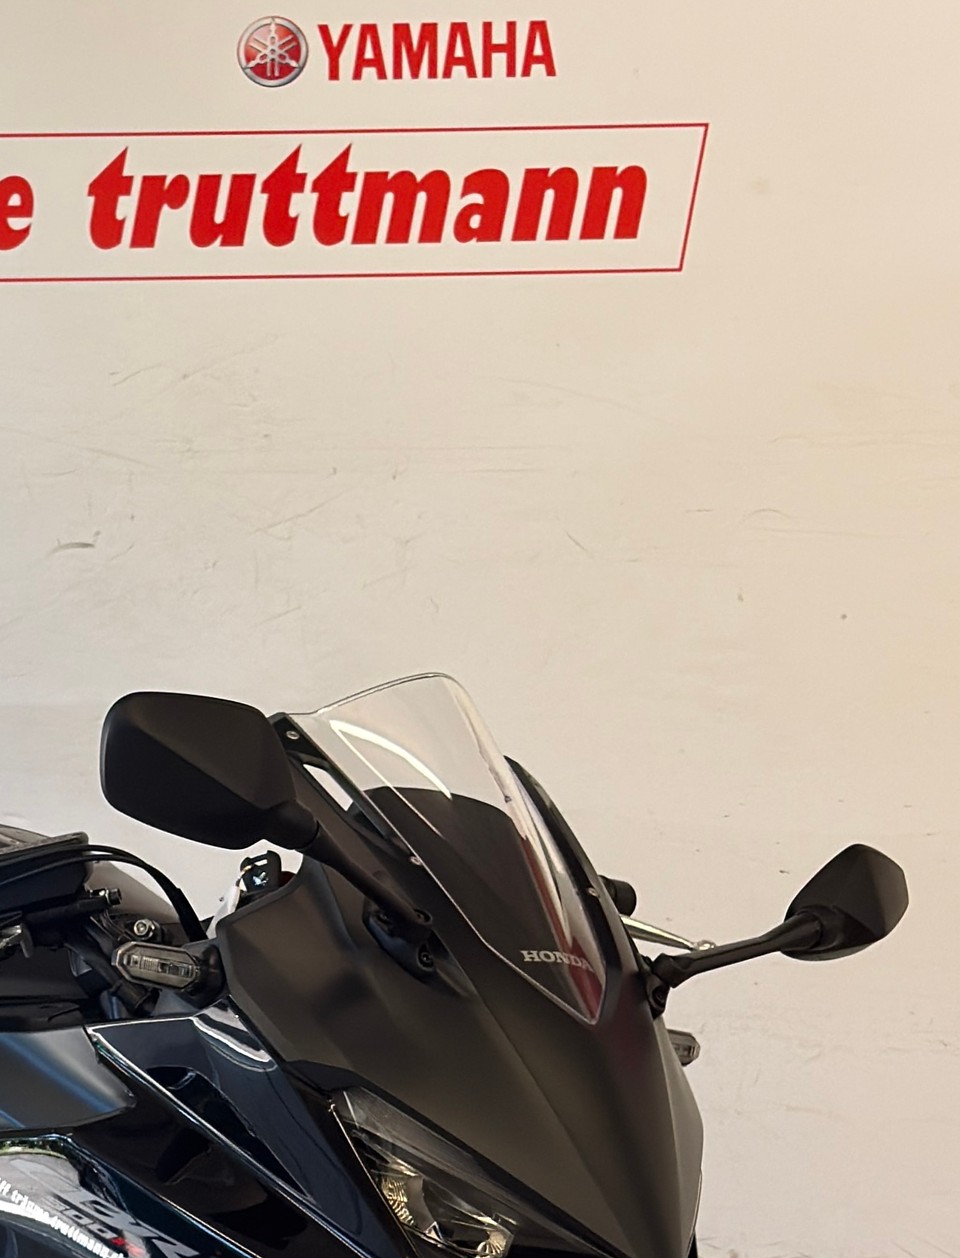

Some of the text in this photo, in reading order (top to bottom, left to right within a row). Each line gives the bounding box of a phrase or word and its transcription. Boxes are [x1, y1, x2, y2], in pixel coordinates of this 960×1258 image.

[317, 20, 557, 81] YAMAHA
[87, 144, 648, 251] truttmann
[520, 950, 596, 974] HONDA
